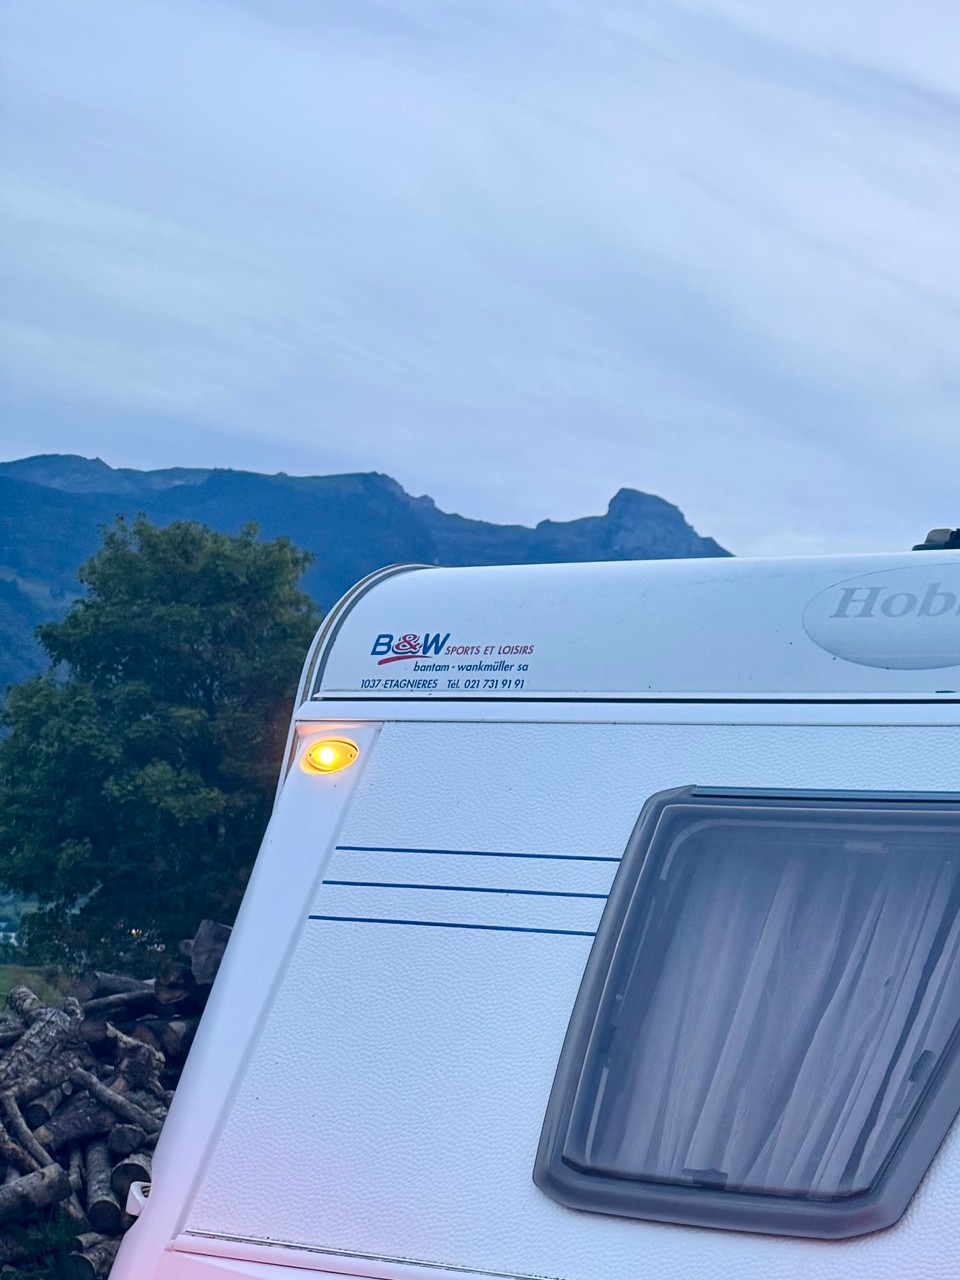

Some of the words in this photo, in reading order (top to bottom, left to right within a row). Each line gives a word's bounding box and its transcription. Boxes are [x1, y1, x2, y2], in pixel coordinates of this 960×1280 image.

[371, 633, 450, 655] B&W
[445, 646, 481, 655] SPORTS
[483, 646, 494, 655] ET
[498, 645, 535, 655] LOISIRS
[413, 661, 449, 672] bantam
[457, 661, 514, 672] wankmüller
[516, 663, 529, 672] sa
[360, 679, 382, 689] 1037
[383, 679, 438, 689] ETAGNIERES
[447, 679, 460, 689] Tél.
[464, 679, 480, 689] 021
[483, 679, 498, 689] 731
[501, 679, 512, 689] 91
[514, 679, 525, 689] 91
